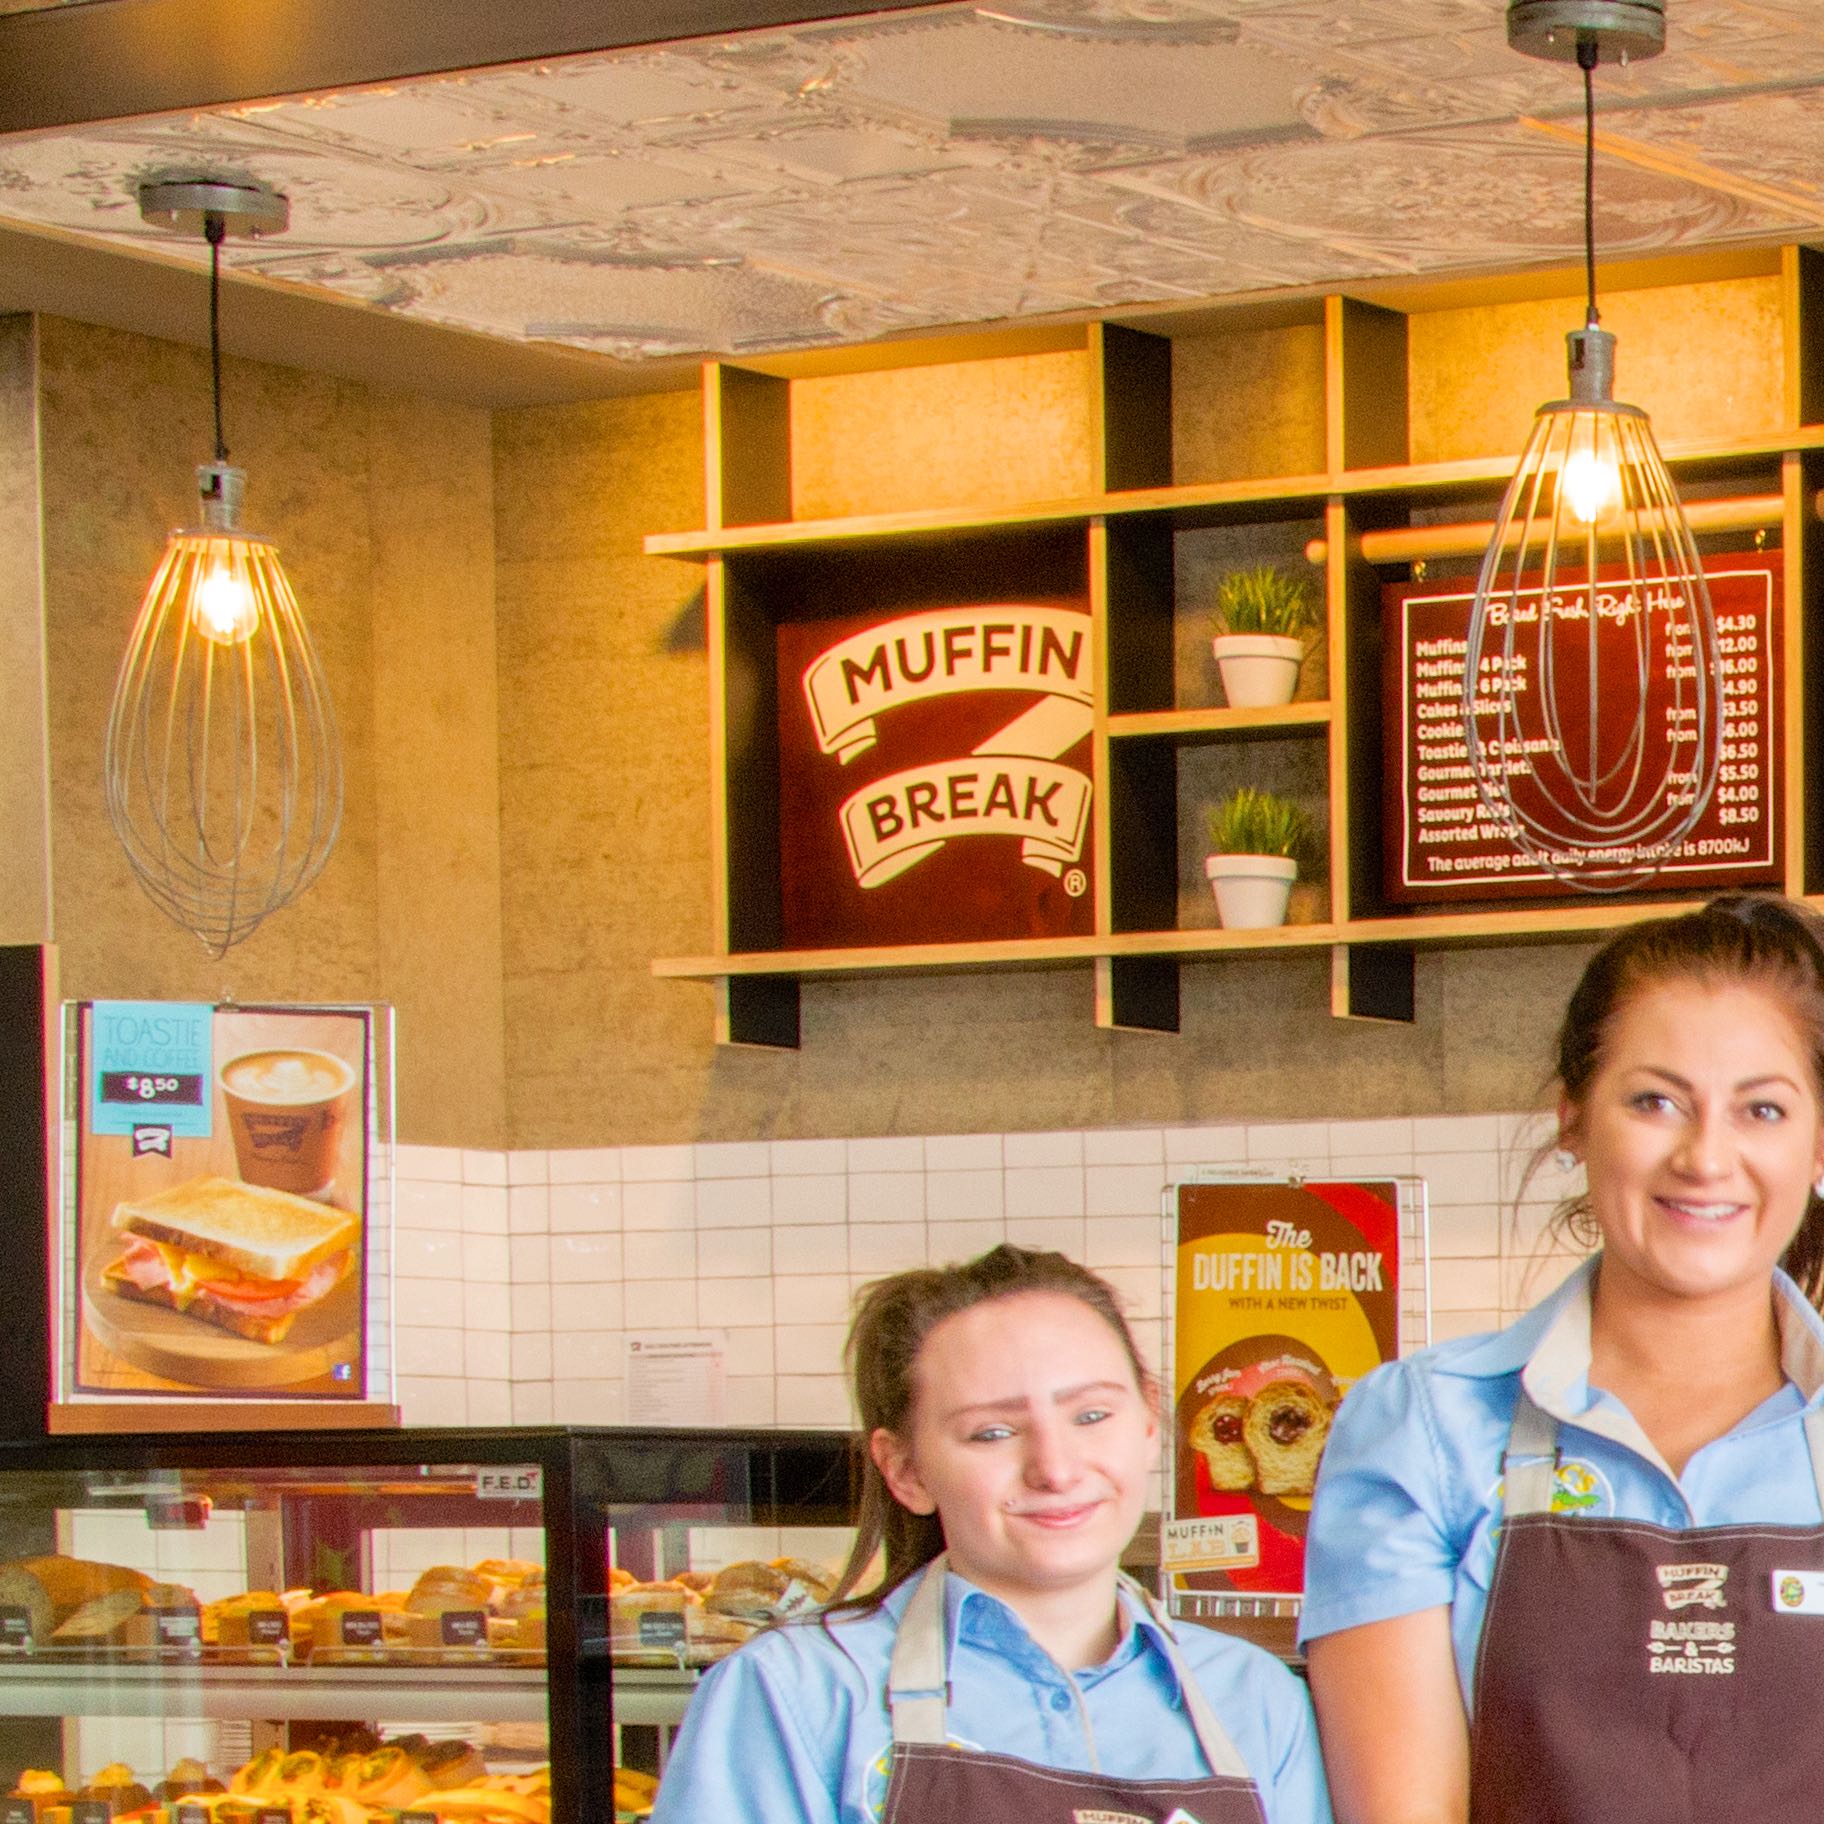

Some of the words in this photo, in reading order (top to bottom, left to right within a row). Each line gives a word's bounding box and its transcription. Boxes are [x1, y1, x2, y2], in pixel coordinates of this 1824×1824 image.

[1717, 615, 1756, 633] $4.30
[840, 624, 1083, 705] MUFFIN
[1417, 702, 1457, 719] Cakes
[1418, 784, 1477, 801] Gourmet
[1719, 764, 1758, 782] $5.50
[866, 773, 1063, 843] BREAK
[1418, 807, 1473, 822] Savoury
[1718, 785, 1758, 804] $4.00
[1419, 825, 1477, 843] Assorted
[1719, 807, 1759, 825] $8.50
[1428, 857, 1452, 871] The
[1455, 854, 1509, 871] average
[104, 1016, 202, 1046] TOASTIE
[1265, 1219, 1312, 1250] The
[1193, 1254, 1281, 1292] DUFFIN
[1290, 1254, 1312, 1291] IS
[1321, 1253, 1383, 1292] BACK
[1229, 1298, 1262, 1310] WITH
[1266, 1298, 1275, 1310] A
[1278, 1297, 1309, 1310] NEW
[1311, 1297, 1347, 1310] TWIST
[1168, 1525, 1223, 1539] MUFFIN
[1664, 1566, 1719, 1578] MUFFIN
[1650, 1621, 1735, 1640] BAKERS
[1685, 1641, 1698, 1656] &
[1650, 1658, 1735, 1674] BARISTAS
